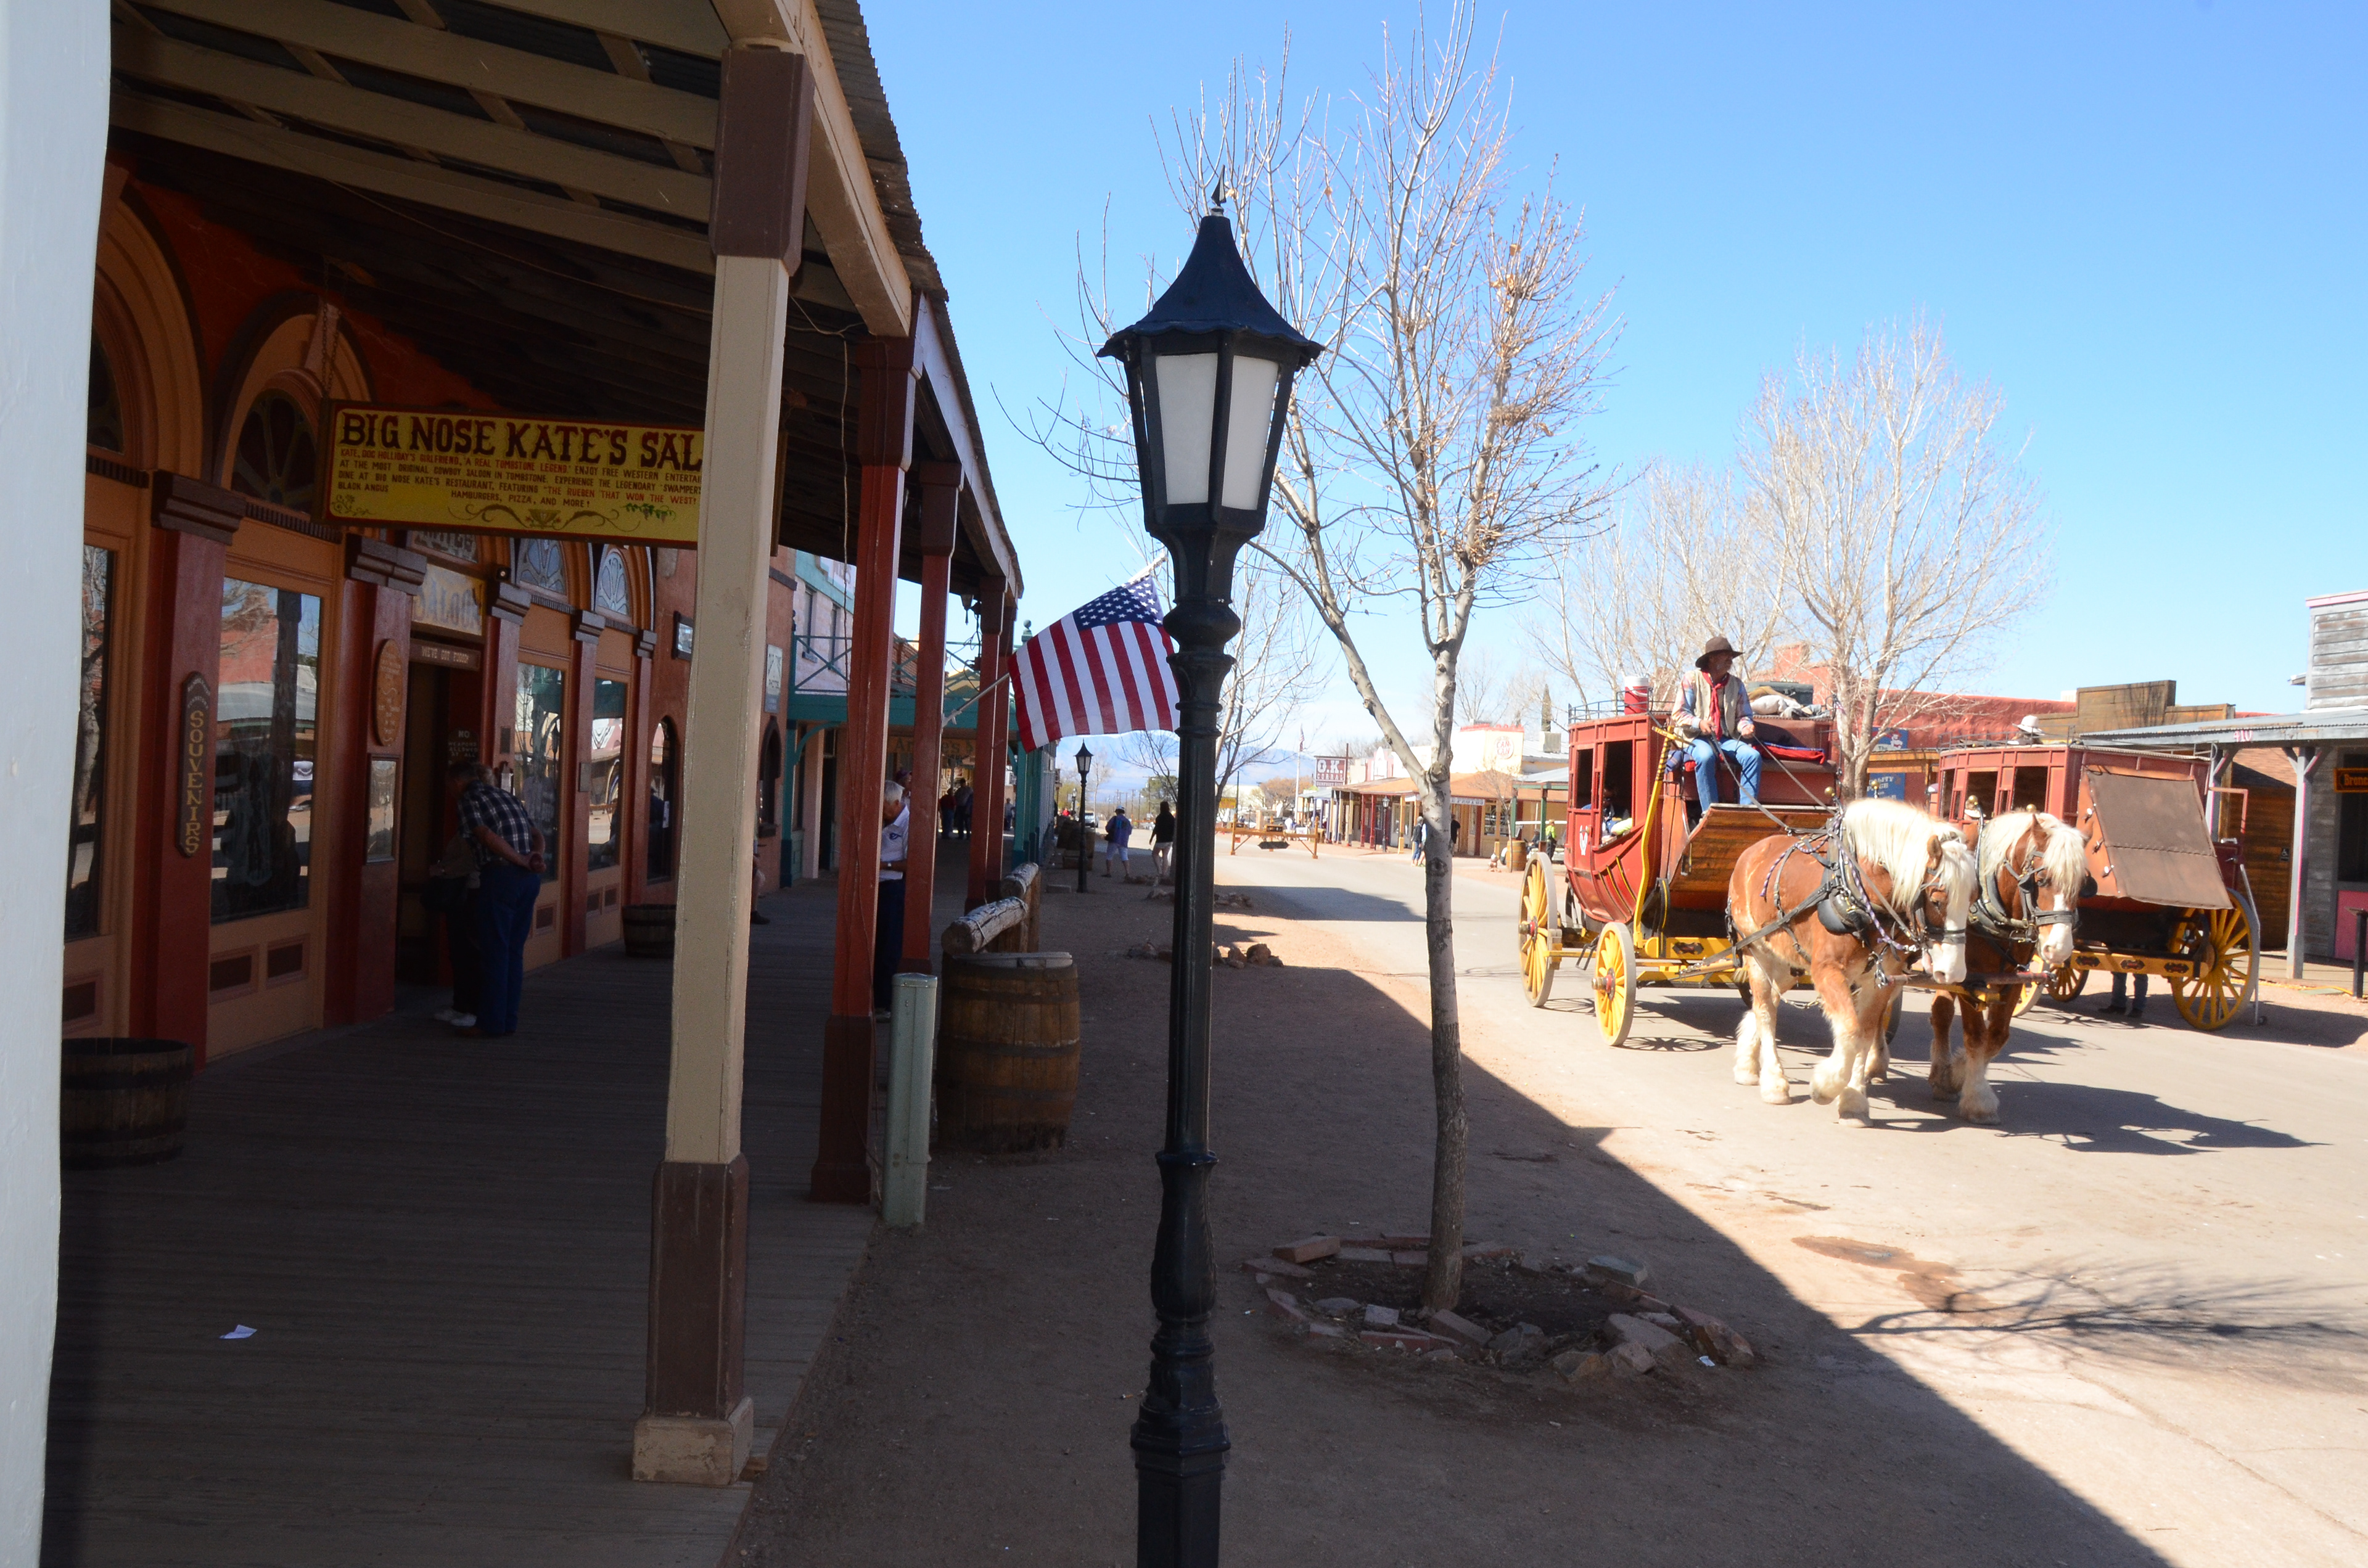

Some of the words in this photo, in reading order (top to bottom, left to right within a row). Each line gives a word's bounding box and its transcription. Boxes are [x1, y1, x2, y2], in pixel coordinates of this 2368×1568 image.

[340, 413, 401, 449] BIG
[409, 416, 496, 455] NOSE
[505, 421, 628, 466] KATE'S
[640, 431, 703, 472] SAL
[340, 459, 349, 468] AT
[354, 461, 368, 469] THE
[372, 461, 392, 471] MOST
[398, 463, 429, 474] ORIGINAL
[434, 467, 461, 476] COWBOY
[467, 469, 491, 478] SALOON
[495, 471, 503, 480] IN
[555, 475, 594, 487] EXPERIENCE
[599, 479, 611, 488] THE
[616, 481, 656, 491] LEGENDARY
[378, 451, 416, 462] HOLLIDAY'S
[475, 458, 491, 468] REAL
[495, 459, 535, 471] TOMBSTONE
[575, 465, 598, 475] ENJOY
[602, 467, 619, 477] FREE
[623, 469, 659, 480] WESTERN
[338, 481, 361, 491] BLACK
[364, 483, 389, 493] ANGUS
[339, 470, 354, 479] DINE
[358, 472, 369, 480] AT
[375, 473, 387, 482] BIG
[392, 474, 410, 484] NOSE
[414, 476, 440, 486] KATE'S
[499, 482, 538, 493] FEATURING
[567, 488, 595, 498] RUEBEN
[625, 493, 645, 501] WON
[650, 494, 664, 503] THE
[670, 495, 696, 506] WEST!
[540, 496, 557, 506] AND
[458, 729, 470, 739] NO
[186, 710, 204, 853] SOUVENIRS
[1317, 760, 1343, 774] O.K.
